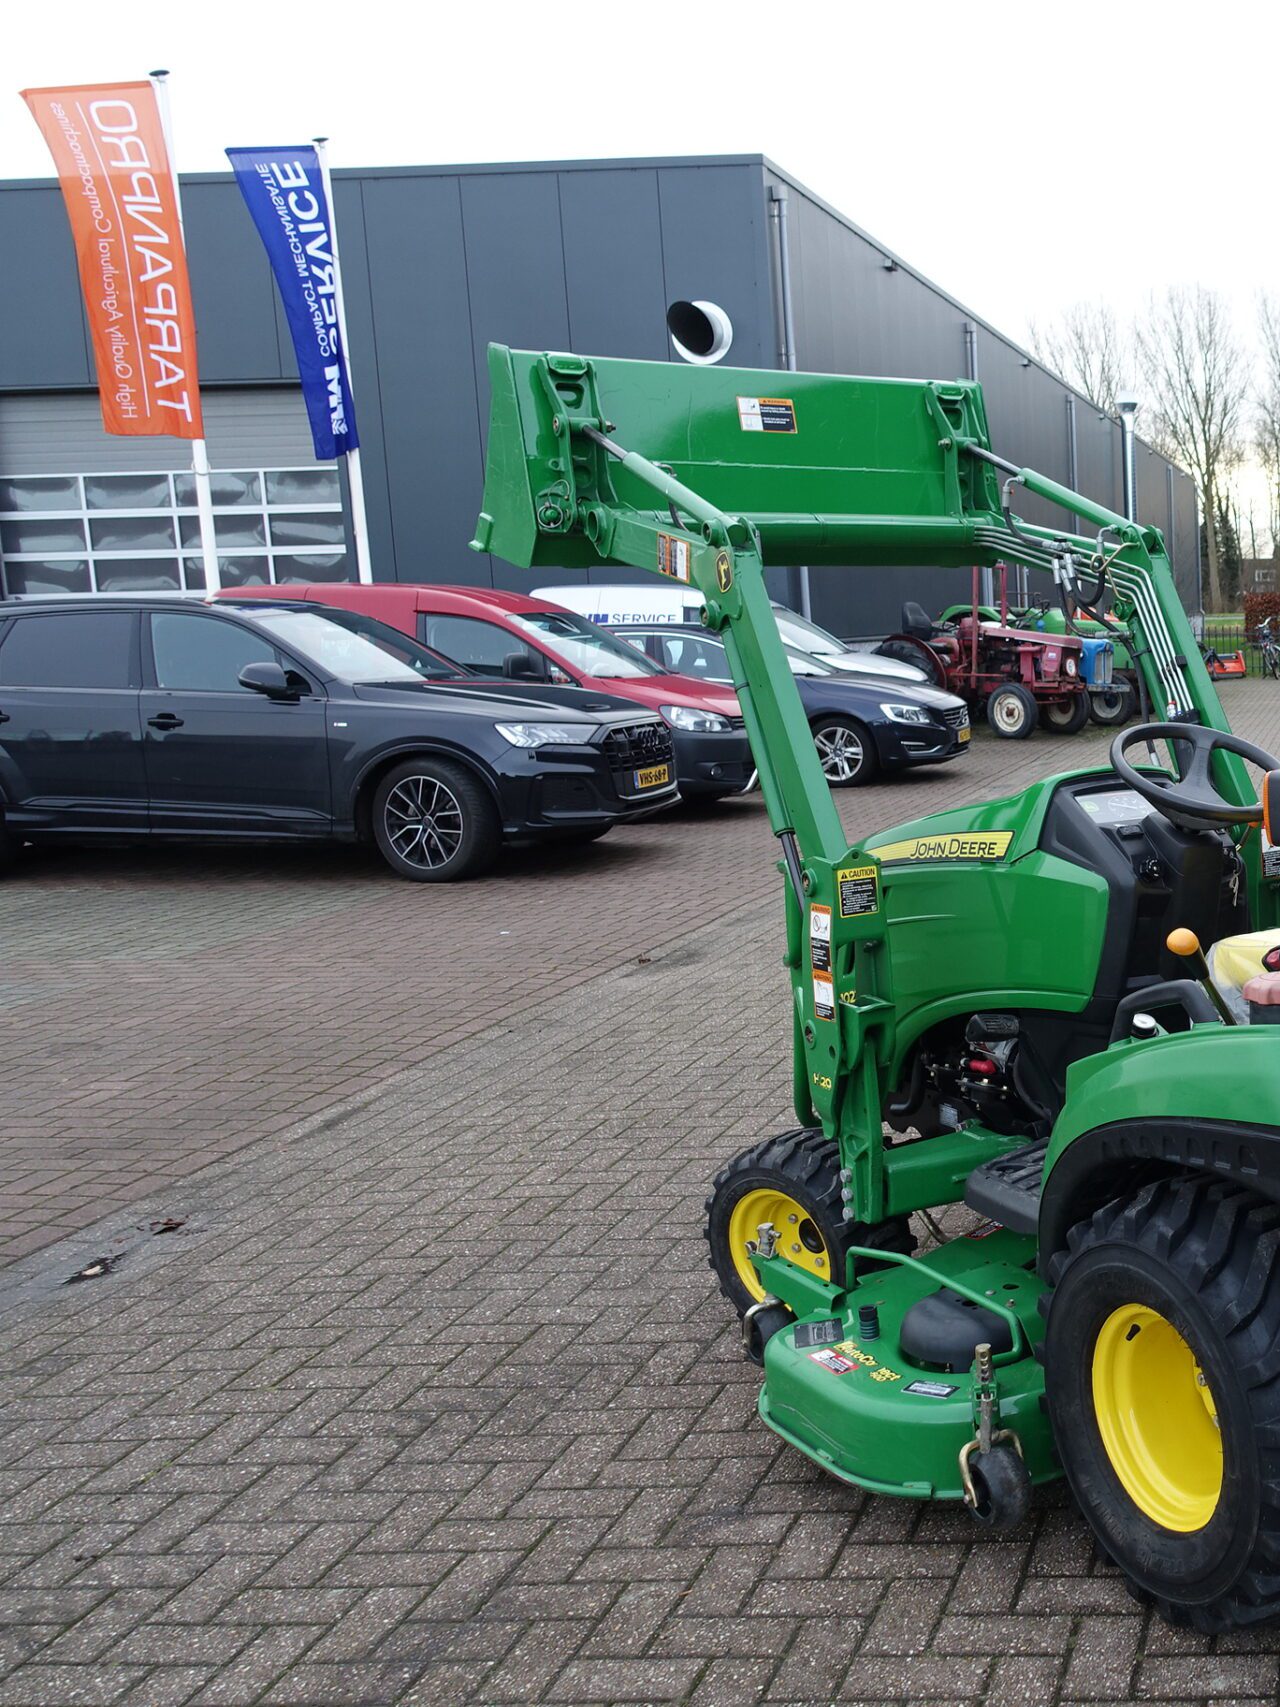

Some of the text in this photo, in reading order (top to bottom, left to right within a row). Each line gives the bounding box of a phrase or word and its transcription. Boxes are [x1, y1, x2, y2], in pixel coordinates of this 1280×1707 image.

[611, 613, 677, 623] SERVICE
[909, 838, 998, 857] JOHN DEERE
[848, 867, 876, 878] CAUTION
